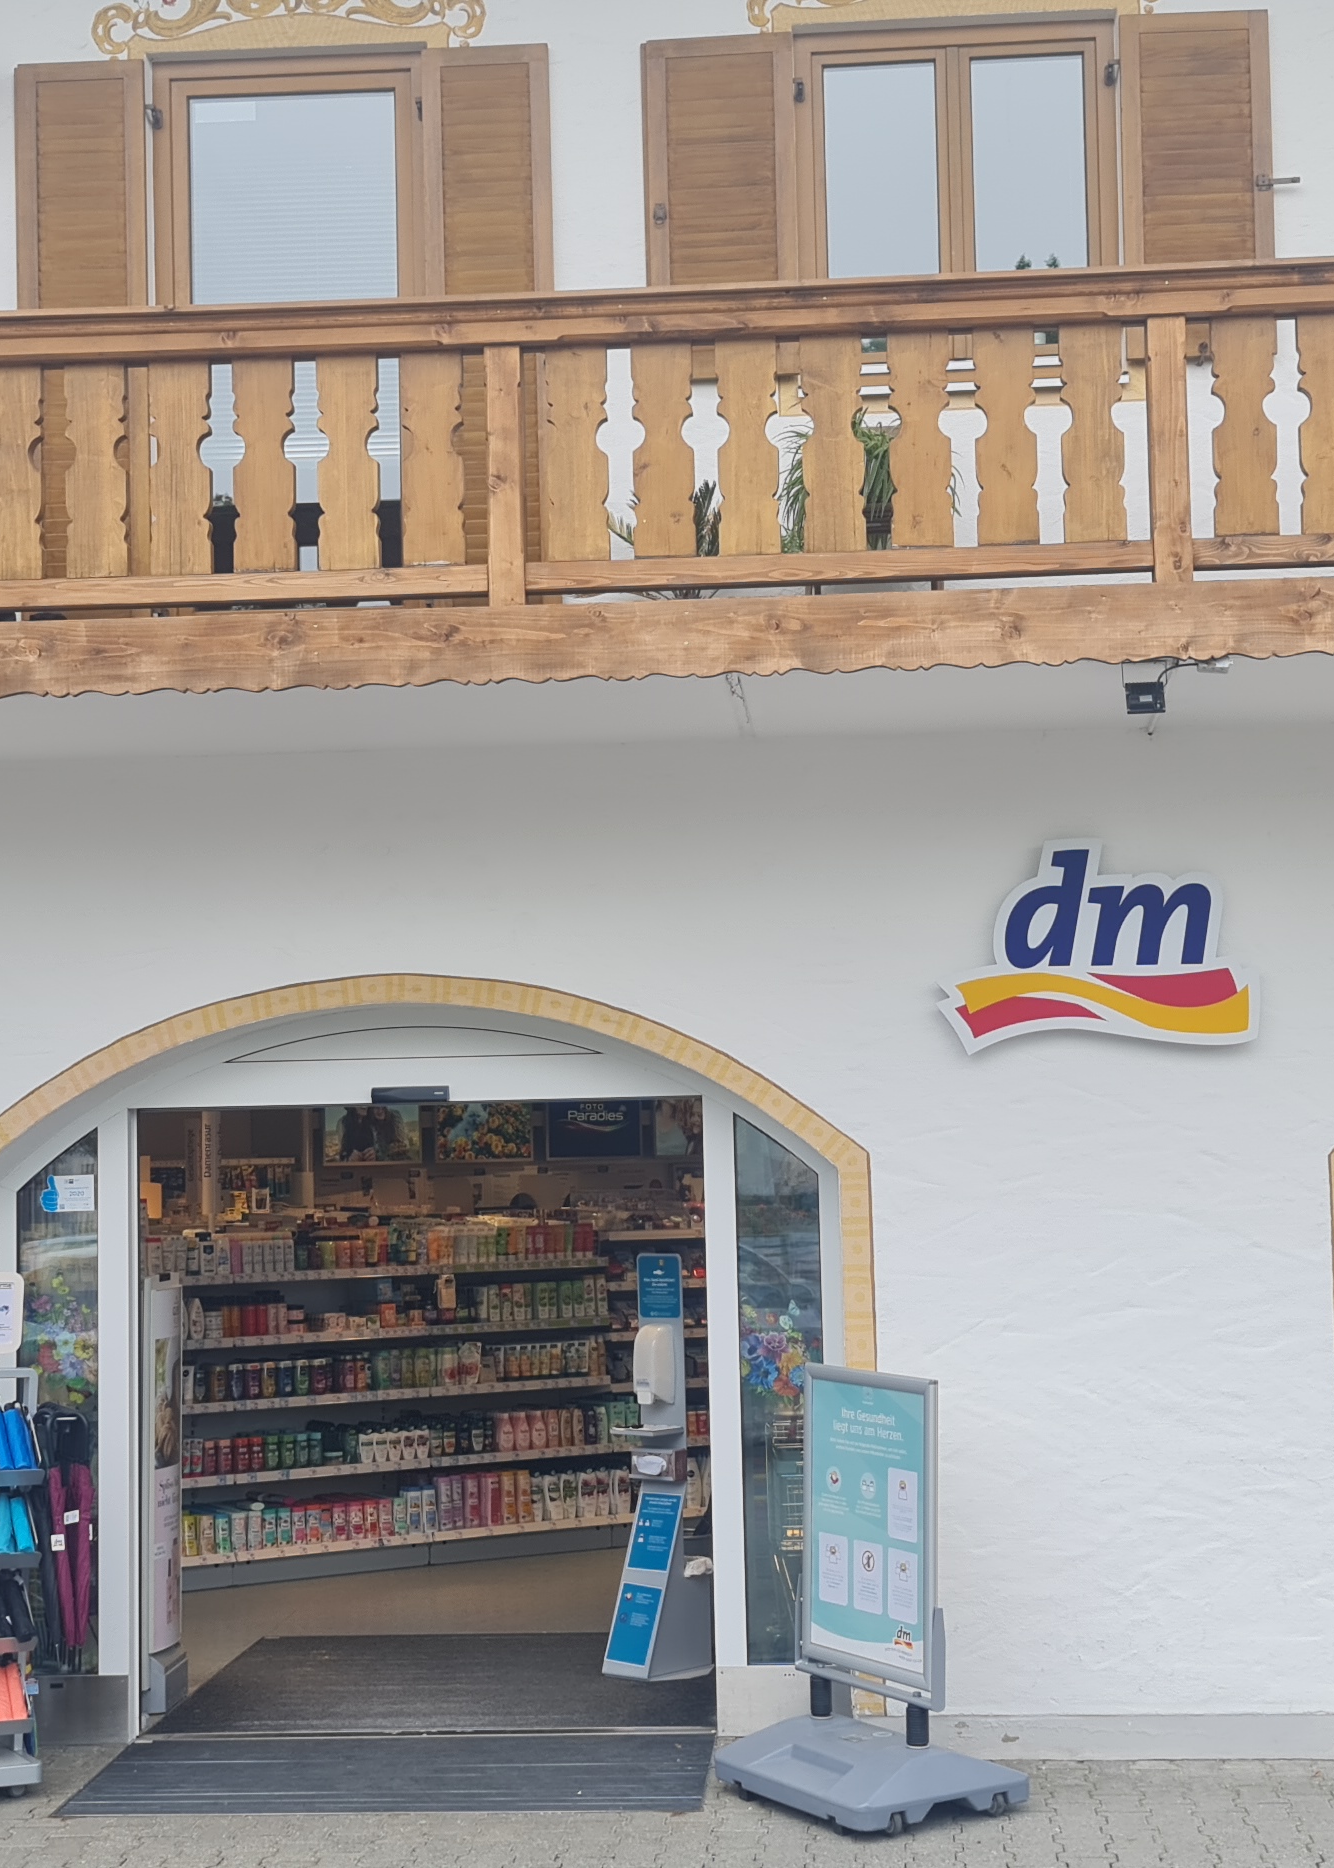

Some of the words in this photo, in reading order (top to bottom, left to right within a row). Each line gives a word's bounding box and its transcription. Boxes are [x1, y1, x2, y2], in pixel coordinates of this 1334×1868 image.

[1005, 849, 1212, 969] dm
[567, 1110, 624, 1121] Paradies
[579, 1103, 604, 1111] FOTO
[203, 1123, 212, 1178] Damenrasur
[841, 1406, 855, 1420] Ihre
[856, 1409, 896, 1427] Gesundheit
[832, 1418, 849, 1435] liegt
[849, 1424, 863, 1436] uns
[863, 1426, 876, 1438] am
[876, 1426, 905, 1442] Herzen.
[896, 1625, 911, 1642] dm
